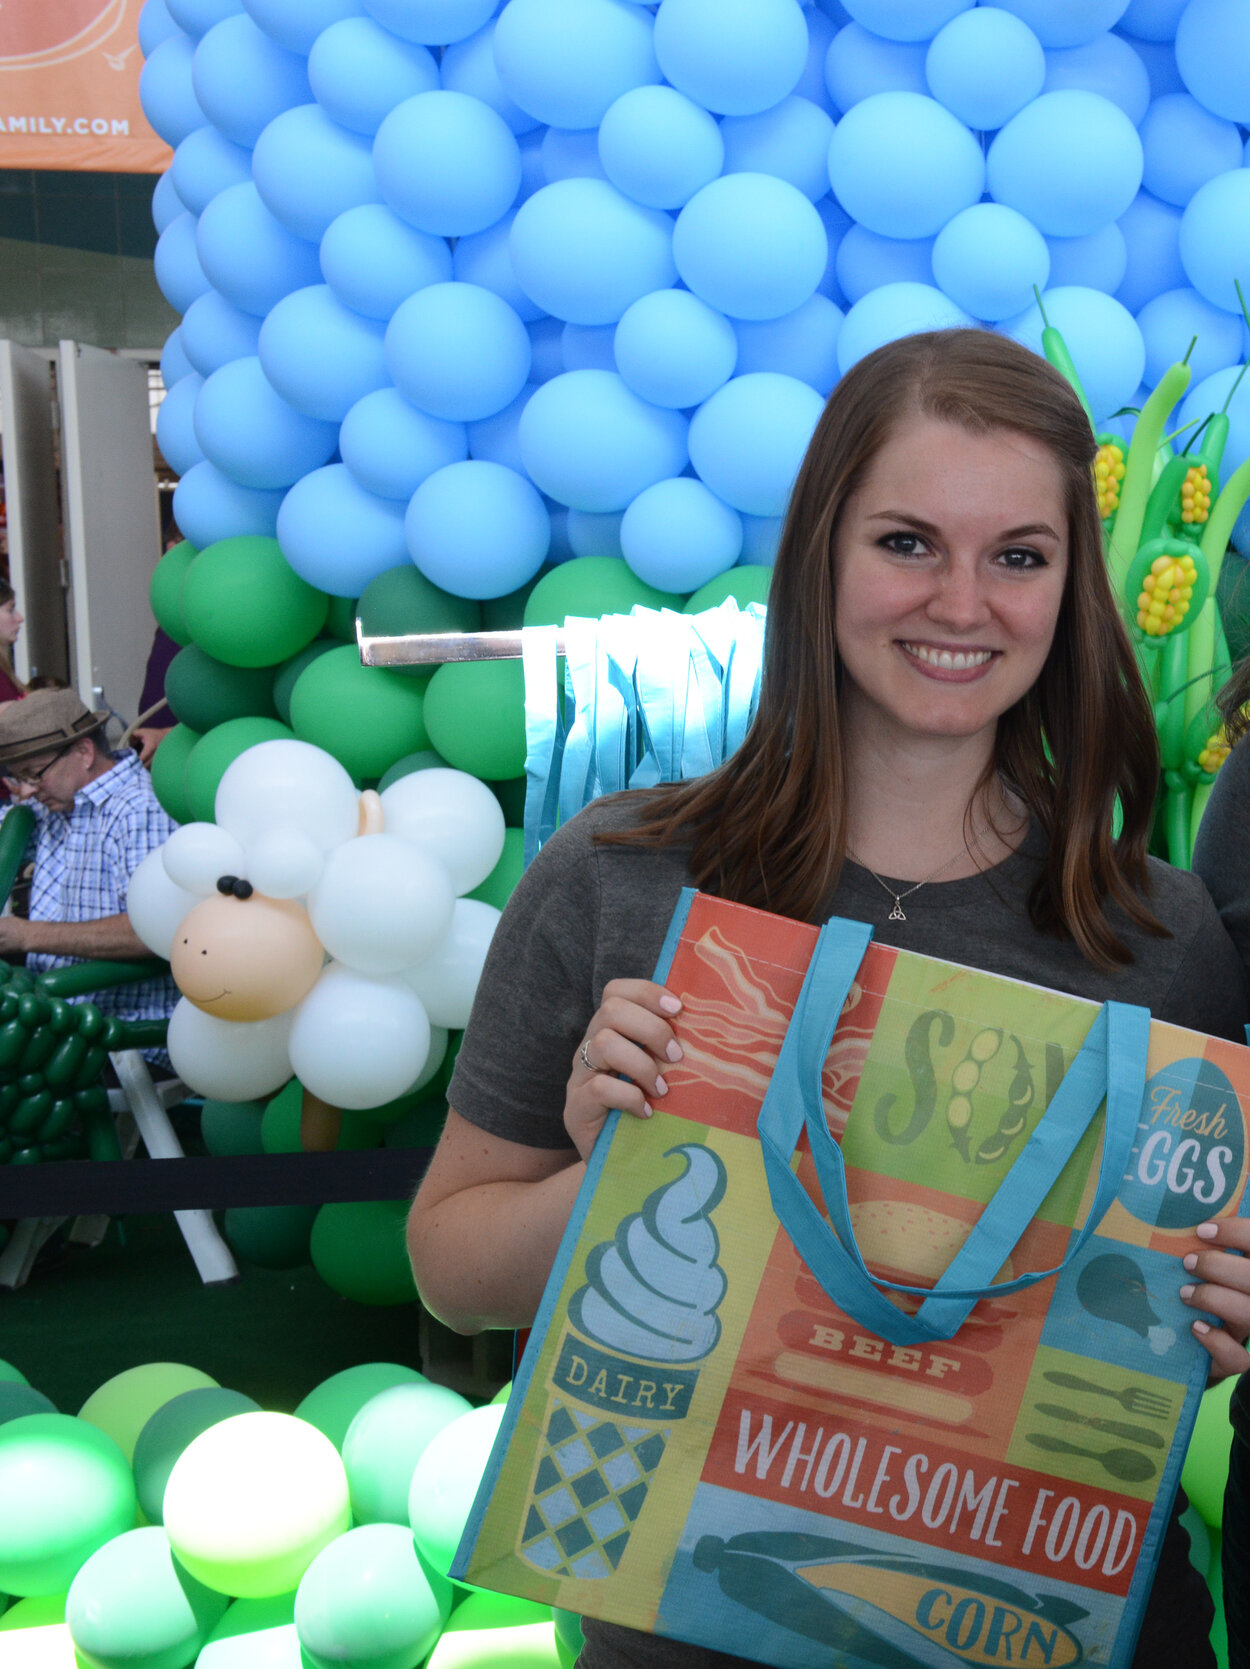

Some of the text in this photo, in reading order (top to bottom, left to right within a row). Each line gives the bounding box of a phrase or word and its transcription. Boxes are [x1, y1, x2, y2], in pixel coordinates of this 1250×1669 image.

[1150, 1085, 1229, 1140] Fresh
[808, 1323, 962, 1380] BEEF
[564, 1356, 685, 1412] DAIRY
[733, 1408, 1138, 1577] WHOLESOME FOOD
[915, 1588, 1059, 1665] CORN
